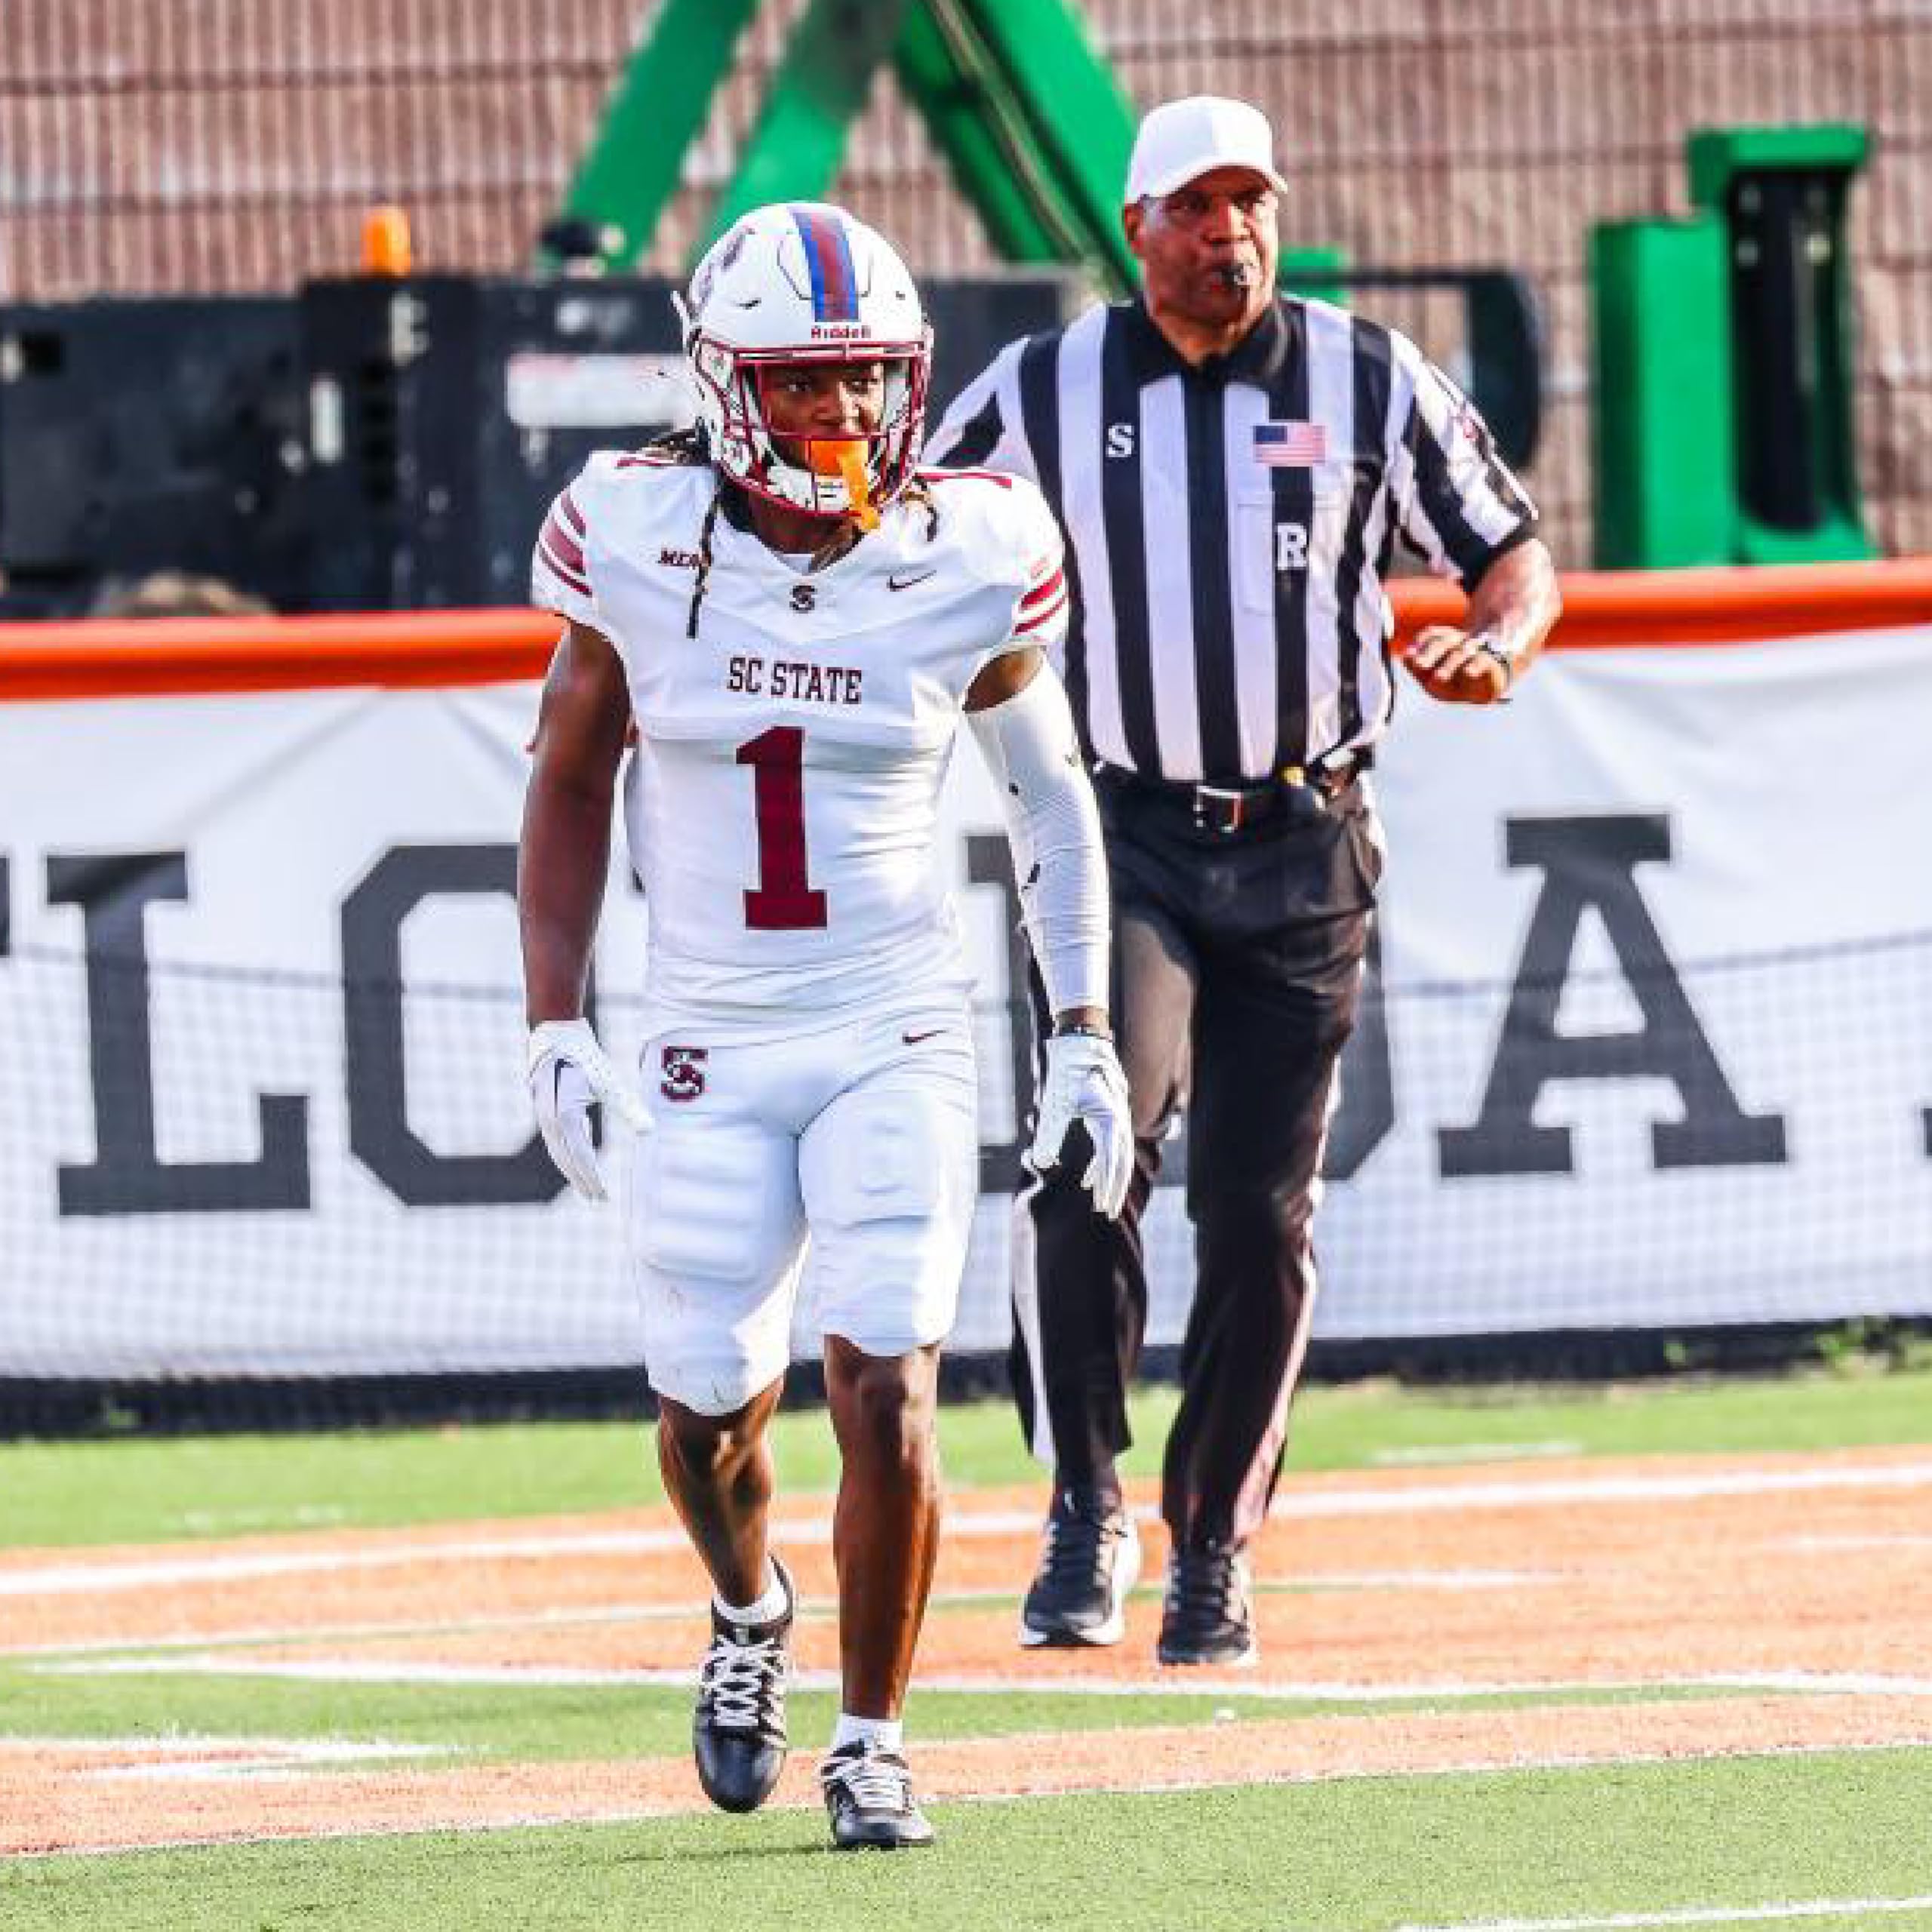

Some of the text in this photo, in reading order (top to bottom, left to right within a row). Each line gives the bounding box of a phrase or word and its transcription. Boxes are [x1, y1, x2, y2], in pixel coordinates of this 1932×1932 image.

[811, 325, 872, 339] Riddell
[1106, 424, 1134, 457] S
[1276, 524, 1307, 571] R
[727, 655, 862, 705] SC STATE
[736, 726, 827, 930] 1
